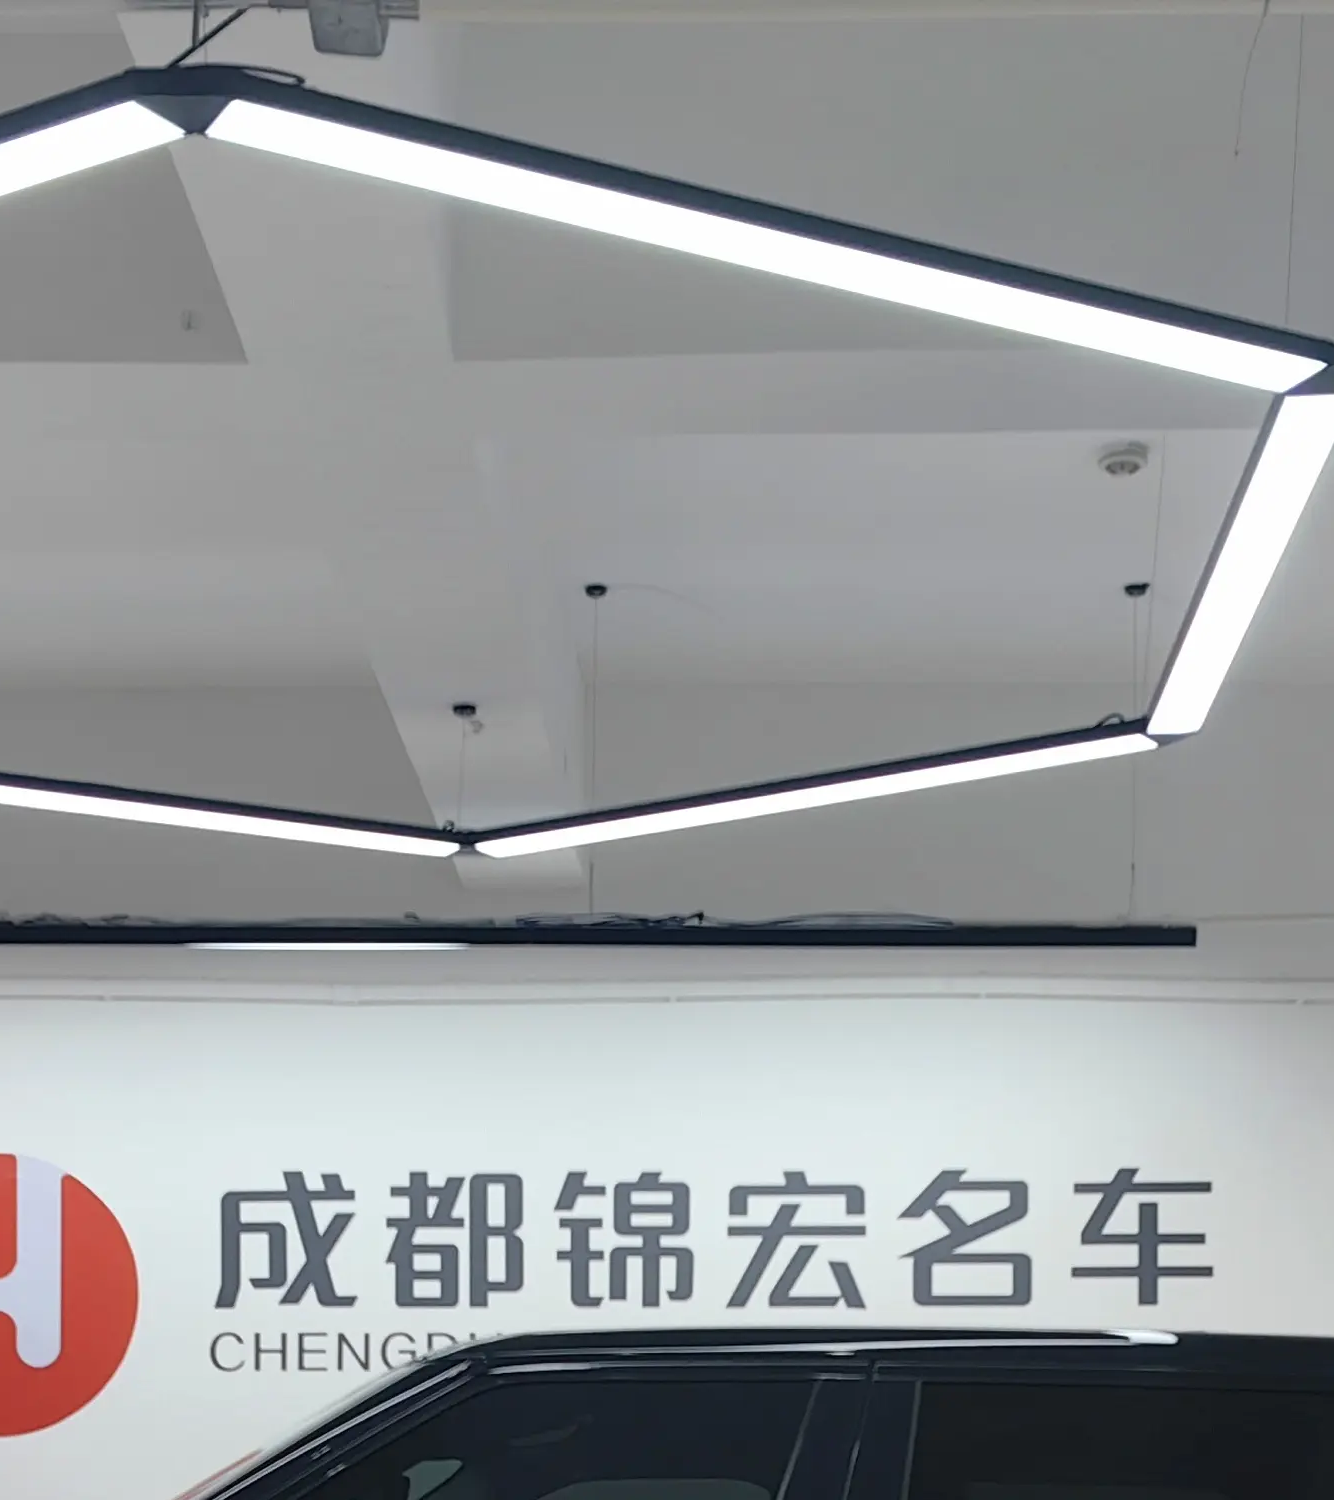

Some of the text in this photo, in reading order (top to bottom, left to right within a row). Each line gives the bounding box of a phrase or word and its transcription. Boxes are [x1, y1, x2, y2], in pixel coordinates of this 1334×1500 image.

[213, 1167, 1214, 1309] 成都锦宏名车
